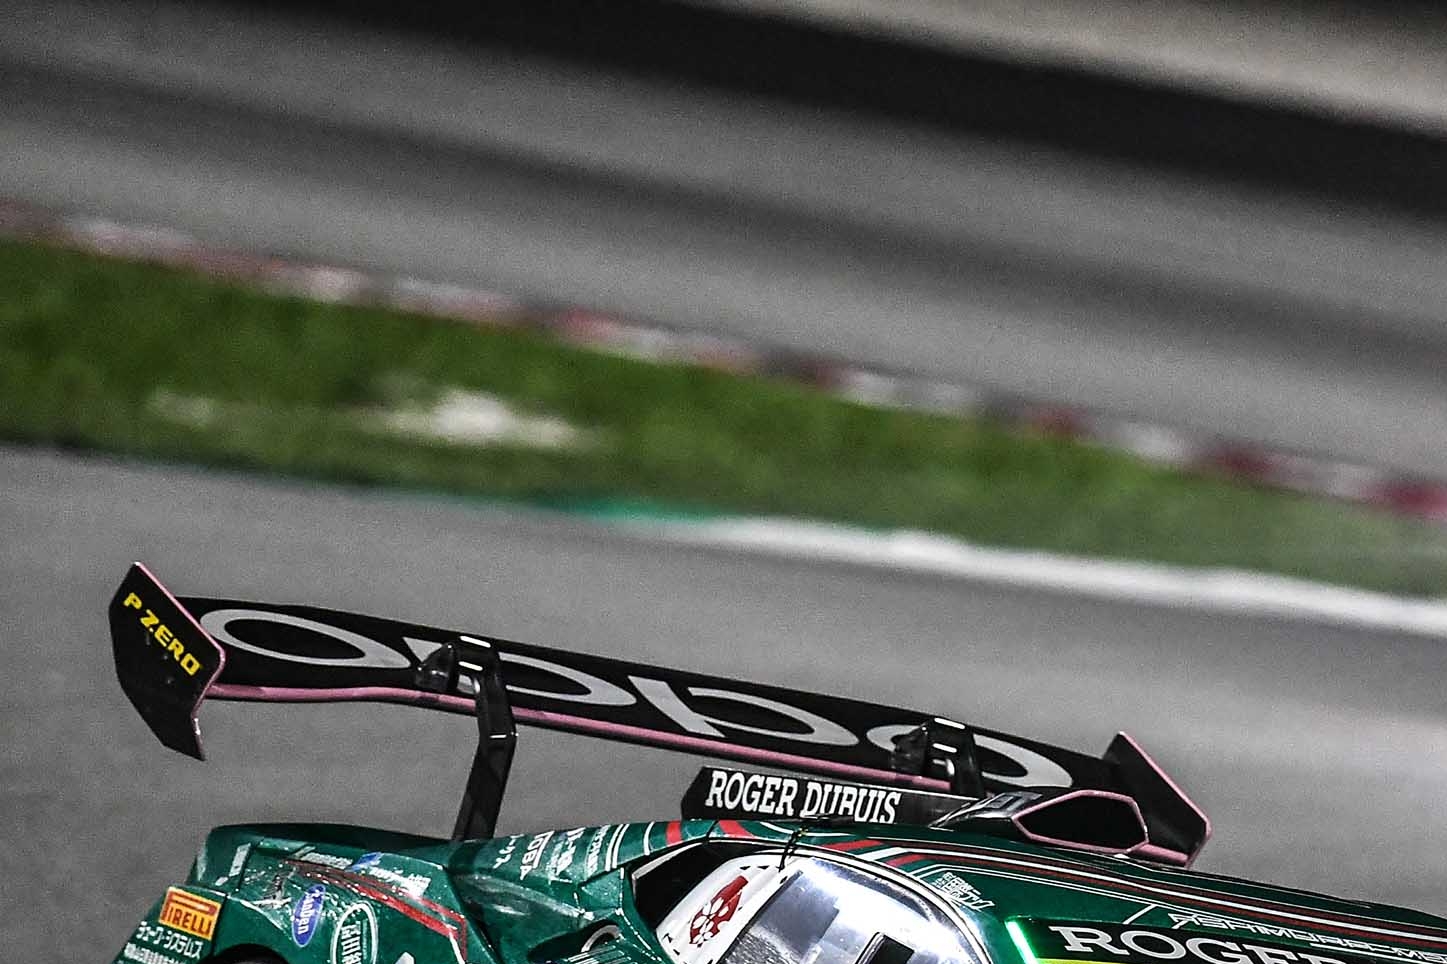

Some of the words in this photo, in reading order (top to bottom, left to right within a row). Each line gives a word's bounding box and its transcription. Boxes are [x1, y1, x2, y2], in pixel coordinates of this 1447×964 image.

[123, 592, 143, 610] P
[140, 608, 201, 676] ZERO
[199, 608, 1074, 789] oppo
[705, 770, 798, 817] ROGER
[800, 781, 902, 825] DUBUIS
[160, 889, 217, 937] PIRELLI
